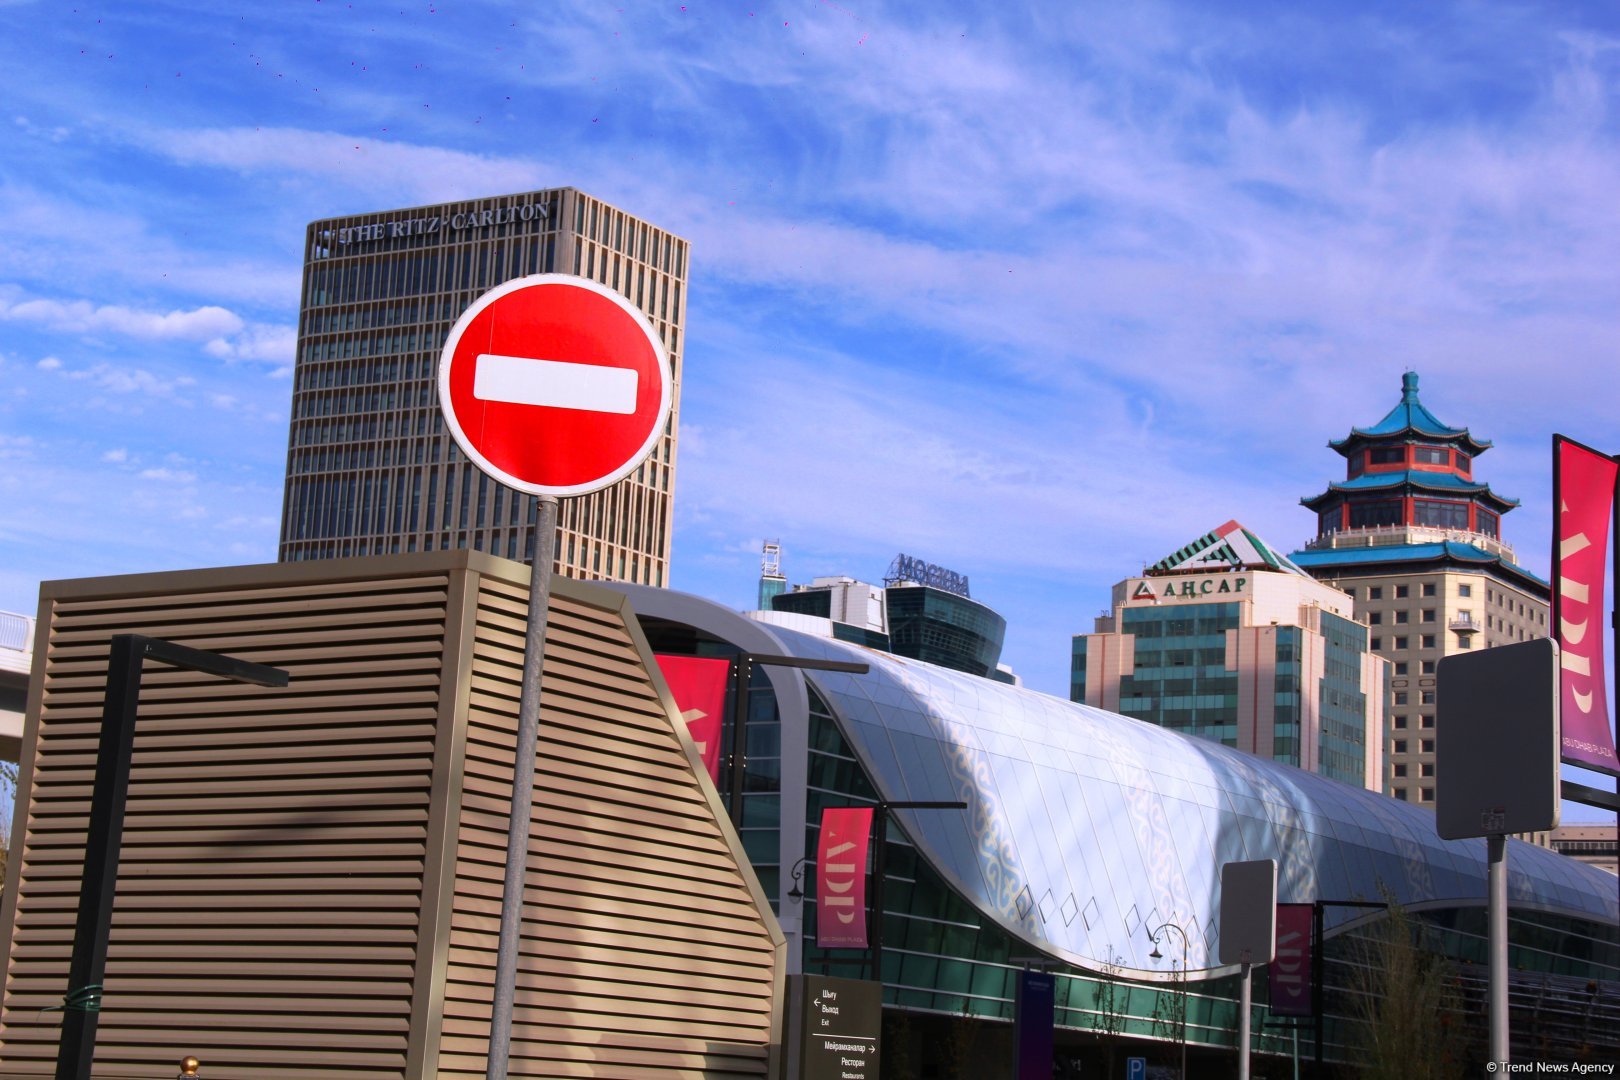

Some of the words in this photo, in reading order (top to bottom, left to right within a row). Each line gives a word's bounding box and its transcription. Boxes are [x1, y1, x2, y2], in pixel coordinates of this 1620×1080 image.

[342, 223, 385, 245] THE
[1163, 577, 1247, 596] АНСАР
[821, 1004, 839, 1015] Выход
[821, 1018, 830, 1026] Exit
[841, 1057, 865, 1068] Ресторан
[1131, 1060, 1142, 1080] P
